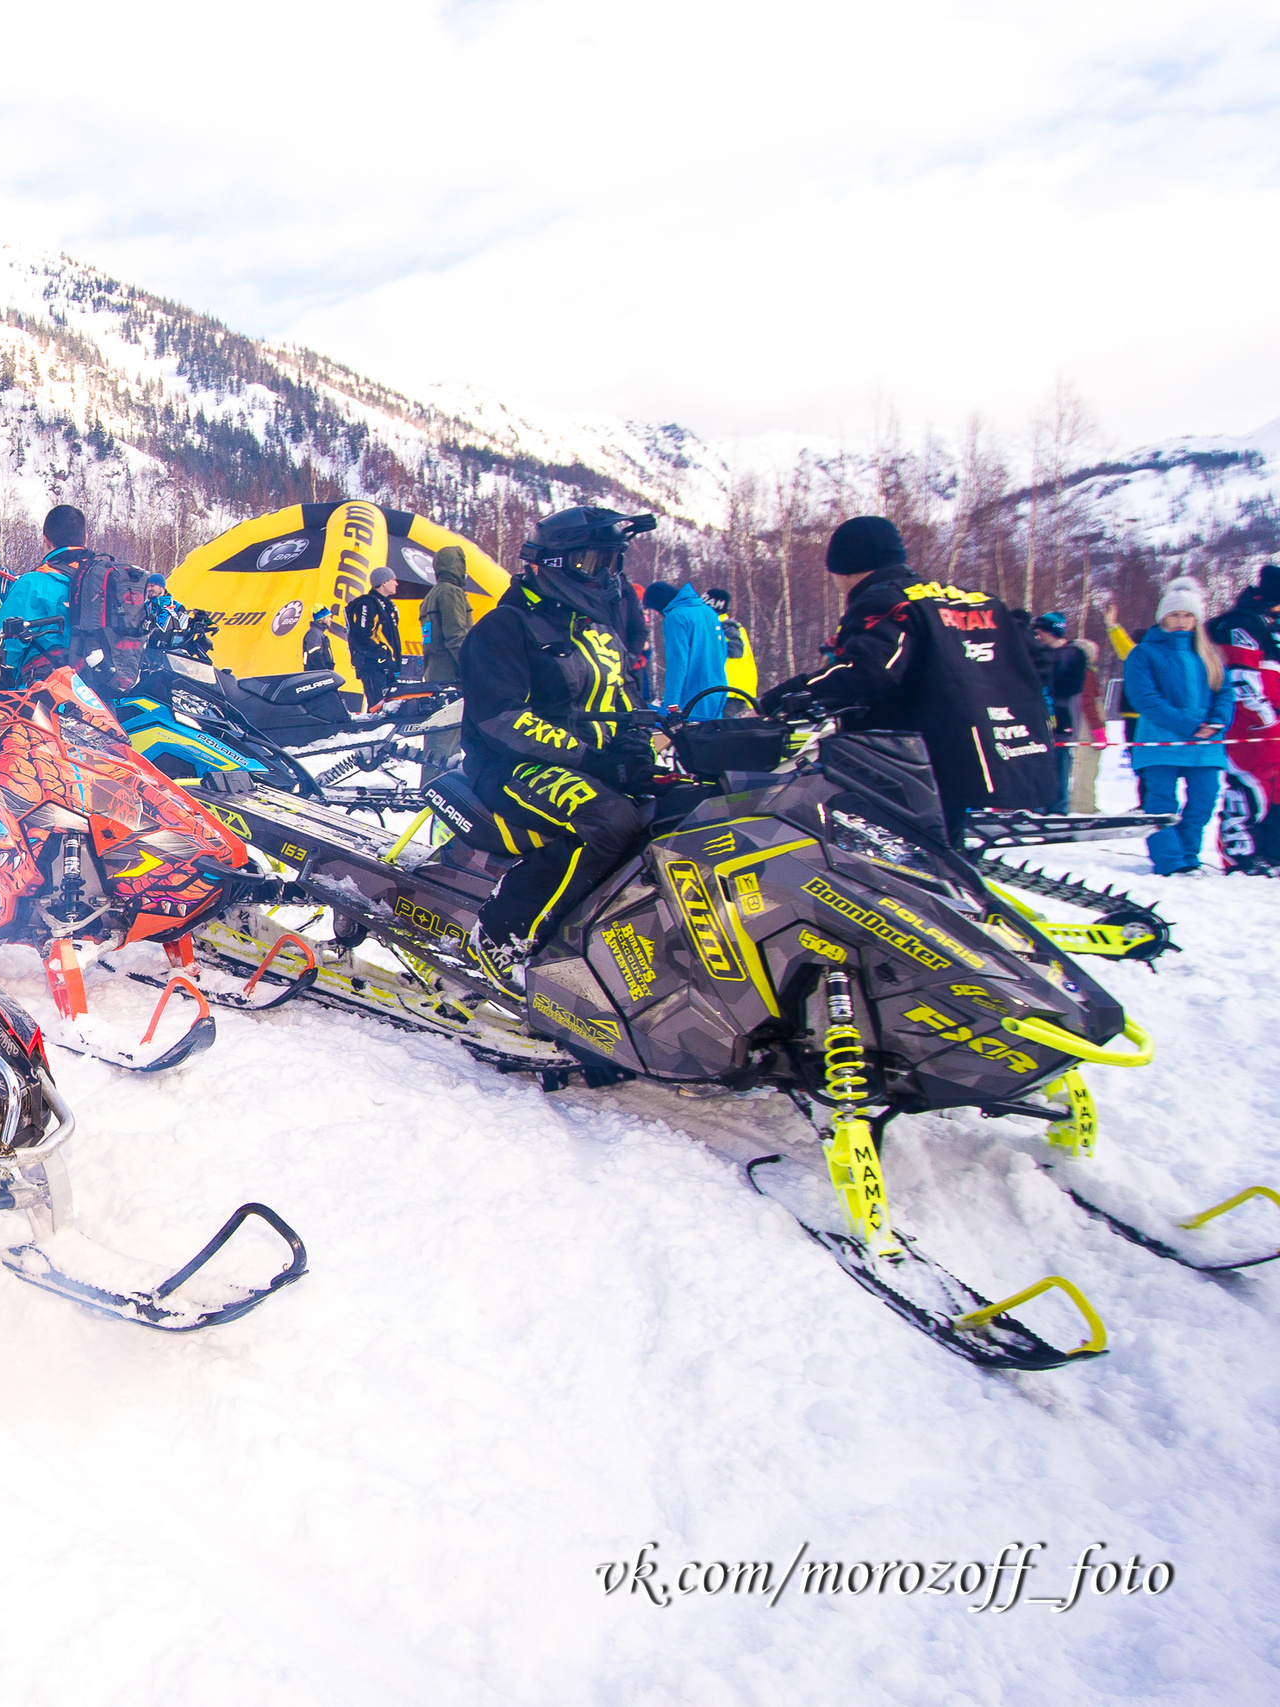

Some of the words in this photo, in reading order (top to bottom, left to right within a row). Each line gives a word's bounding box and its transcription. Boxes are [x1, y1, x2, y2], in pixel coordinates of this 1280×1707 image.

[272, 552, 300, 562] BRP
[281, 617, 299, 626] BRP
[295, 677, 335, 694] POLARIS
[197, 733, 249, 766] POLARIS
[513, 711, 567, 748] FXR
[424, 788, 474, 834] POLARIS
[529, 766, 598, 816] FXR
[280, 842, 308, 861] 163
[800, 877, 952, 970] BoonDocker
[878, 897, 986, 969] POLARIS
[601, 928, 645, 1002] ADVENTURE
[612, 921, 653, 997] BACKCOUNTRY
[534, 992, 616, 1049] SKINZ
[902, 999, 1040, 1074] FXR
